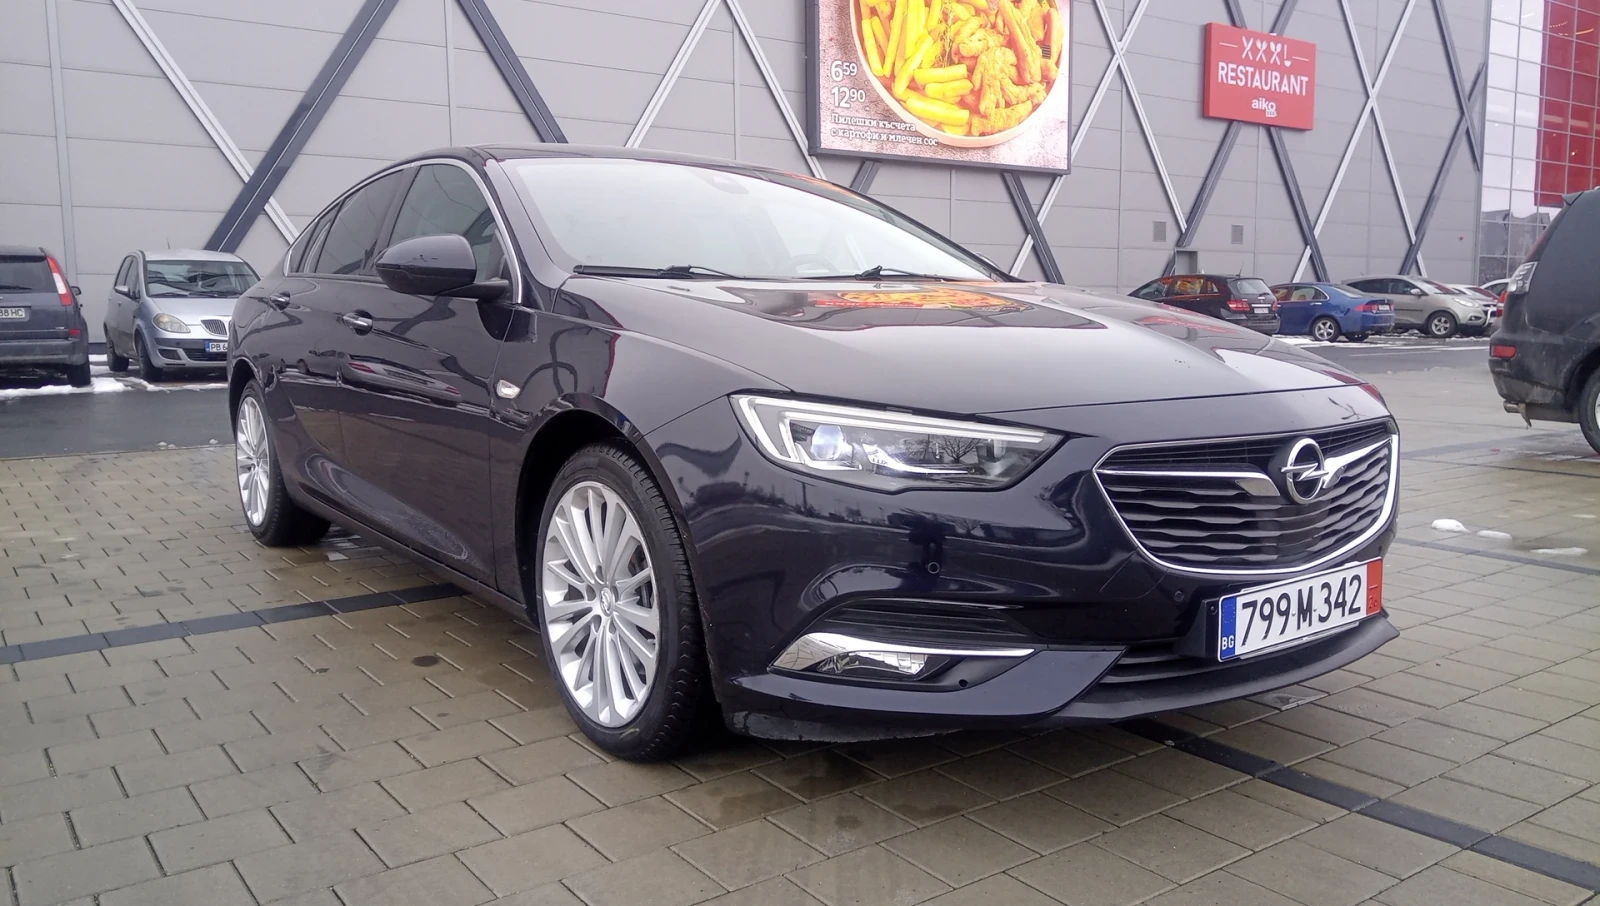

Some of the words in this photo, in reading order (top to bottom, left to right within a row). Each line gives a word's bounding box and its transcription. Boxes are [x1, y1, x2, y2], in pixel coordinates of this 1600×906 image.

[1218, 61, 1309, 96] RESTAURANT
[1251, 97, 1276, 111] aiko
[831, 113, 877, 126] Пилешки
[879, 119, 916, 131] късчета
[830, 128, 837, 136] с
[838, 128, 879, 141] картофи
[880, 132, 887, 140] и
[889, 135, 922, 144] млечен
[923, 137, 938, 146] сос
[1222, 635, 1234, 650] BG
